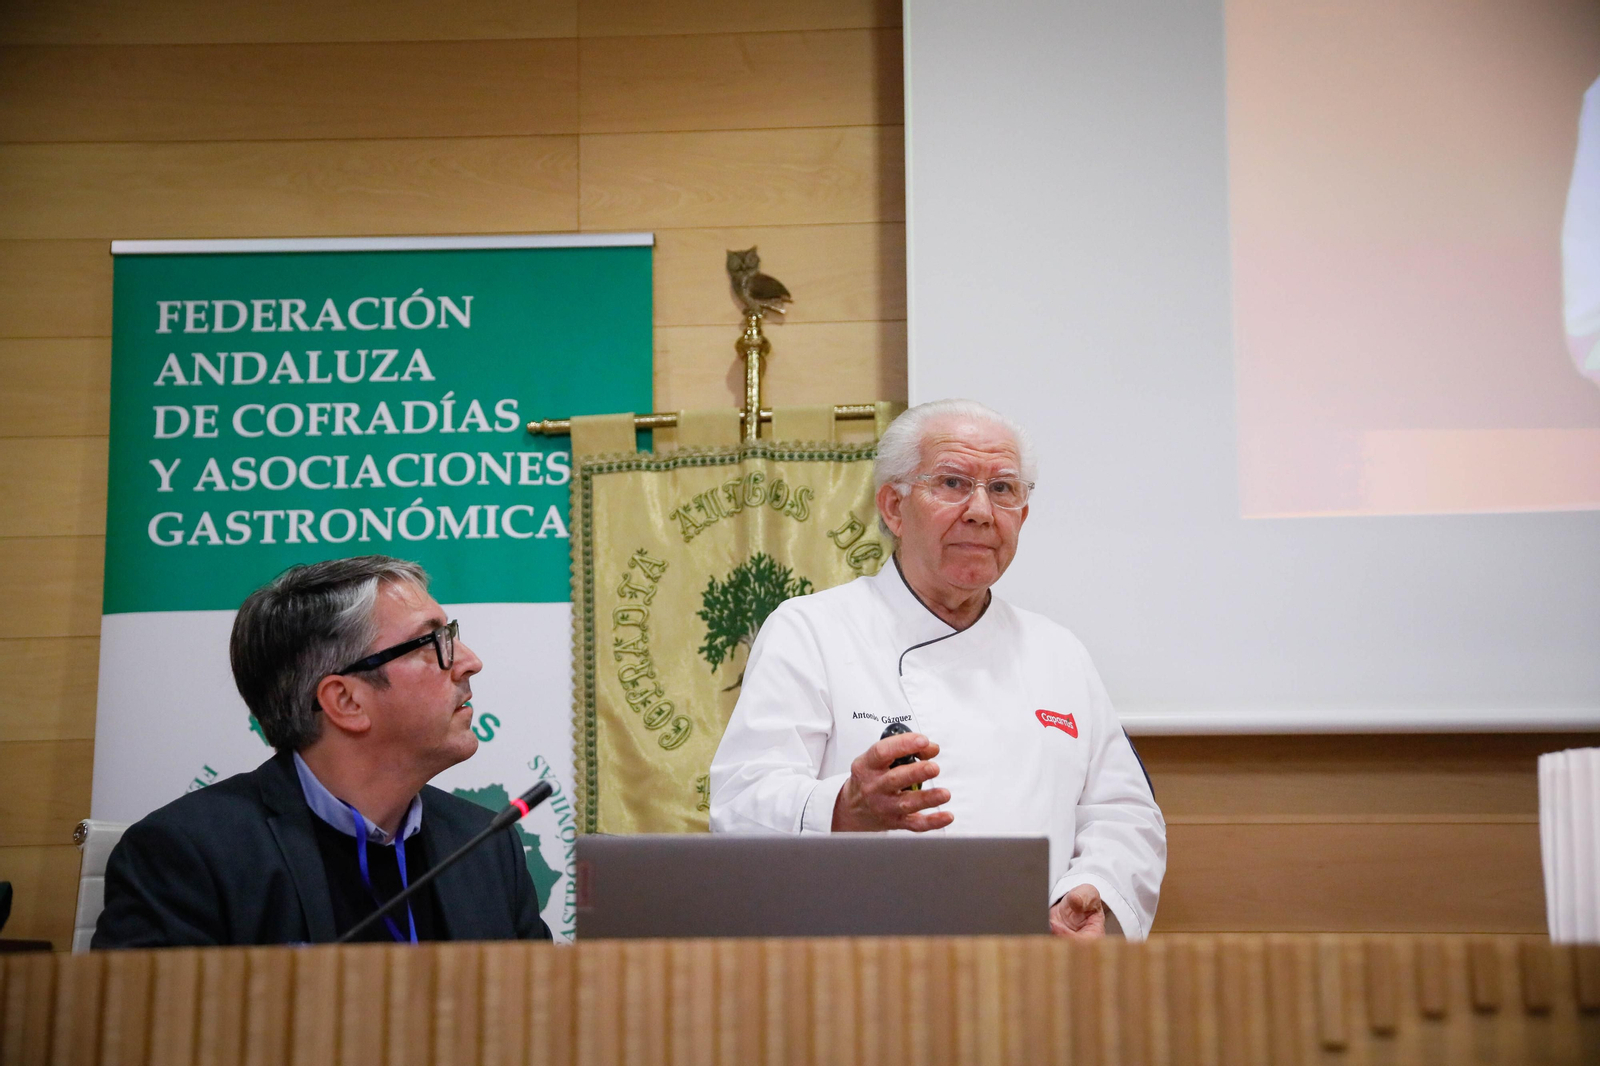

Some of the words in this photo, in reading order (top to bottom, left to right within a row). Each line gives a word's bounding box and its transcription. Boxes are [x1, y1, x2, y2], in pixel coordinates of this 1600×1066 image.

[155, 288, 475, 334] FEDERACIÓN
[153, 348, 436, 386] ANDALUZA
[152, 405, 219, 439] DE
[232, 390, 521, 438] COFRADÍAS
[149, 458, 181, 492] Y
[193, 451, 570, 492] ASOCIACIONES
[669, 470, 815, 543] AMIGOS
[826, 510, 884, 576] DE
[852, 711, 879, 722] Antonio
[881, 714, 912, 725] Gázquez
